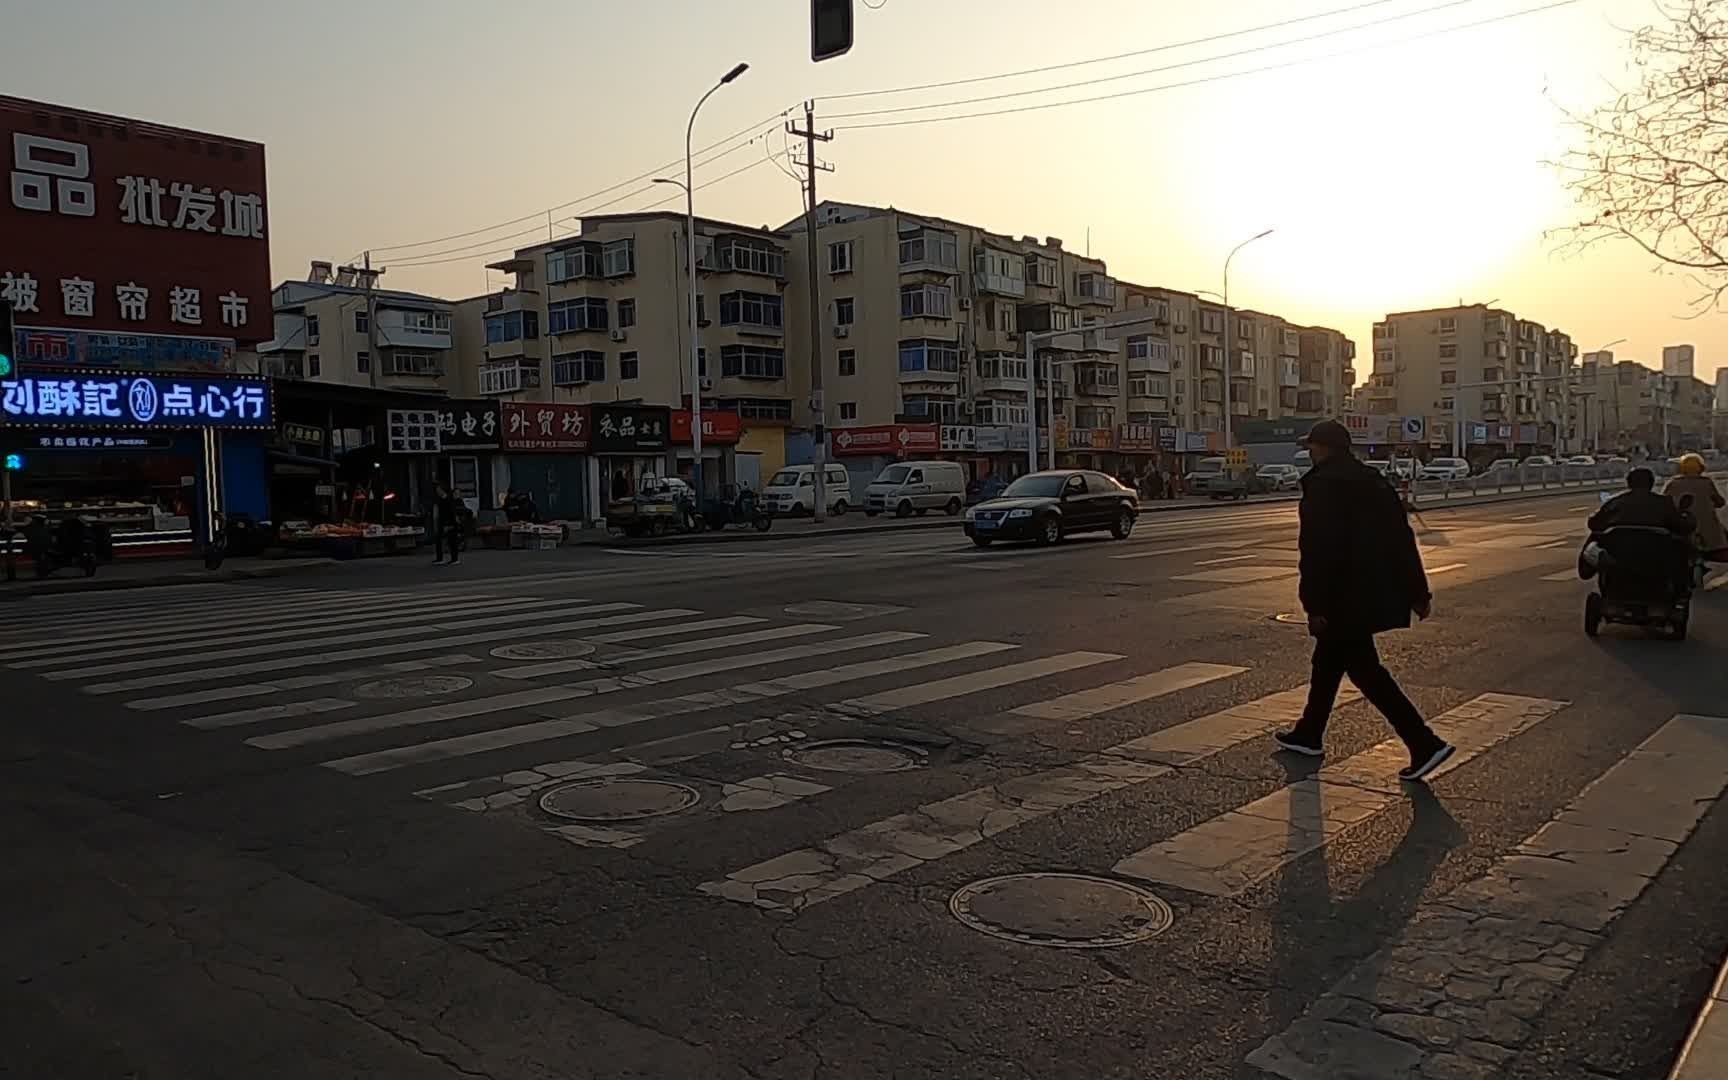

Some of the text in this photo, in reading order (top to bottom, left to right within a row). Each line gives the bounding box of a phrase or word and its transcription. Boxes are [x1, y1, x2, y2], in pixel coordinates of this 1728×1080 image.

[10, 132, 264, 239] 品 批发城
[162, 385, 263, 418] 点心行
[509, 409, 584, 437] 外贸坊
